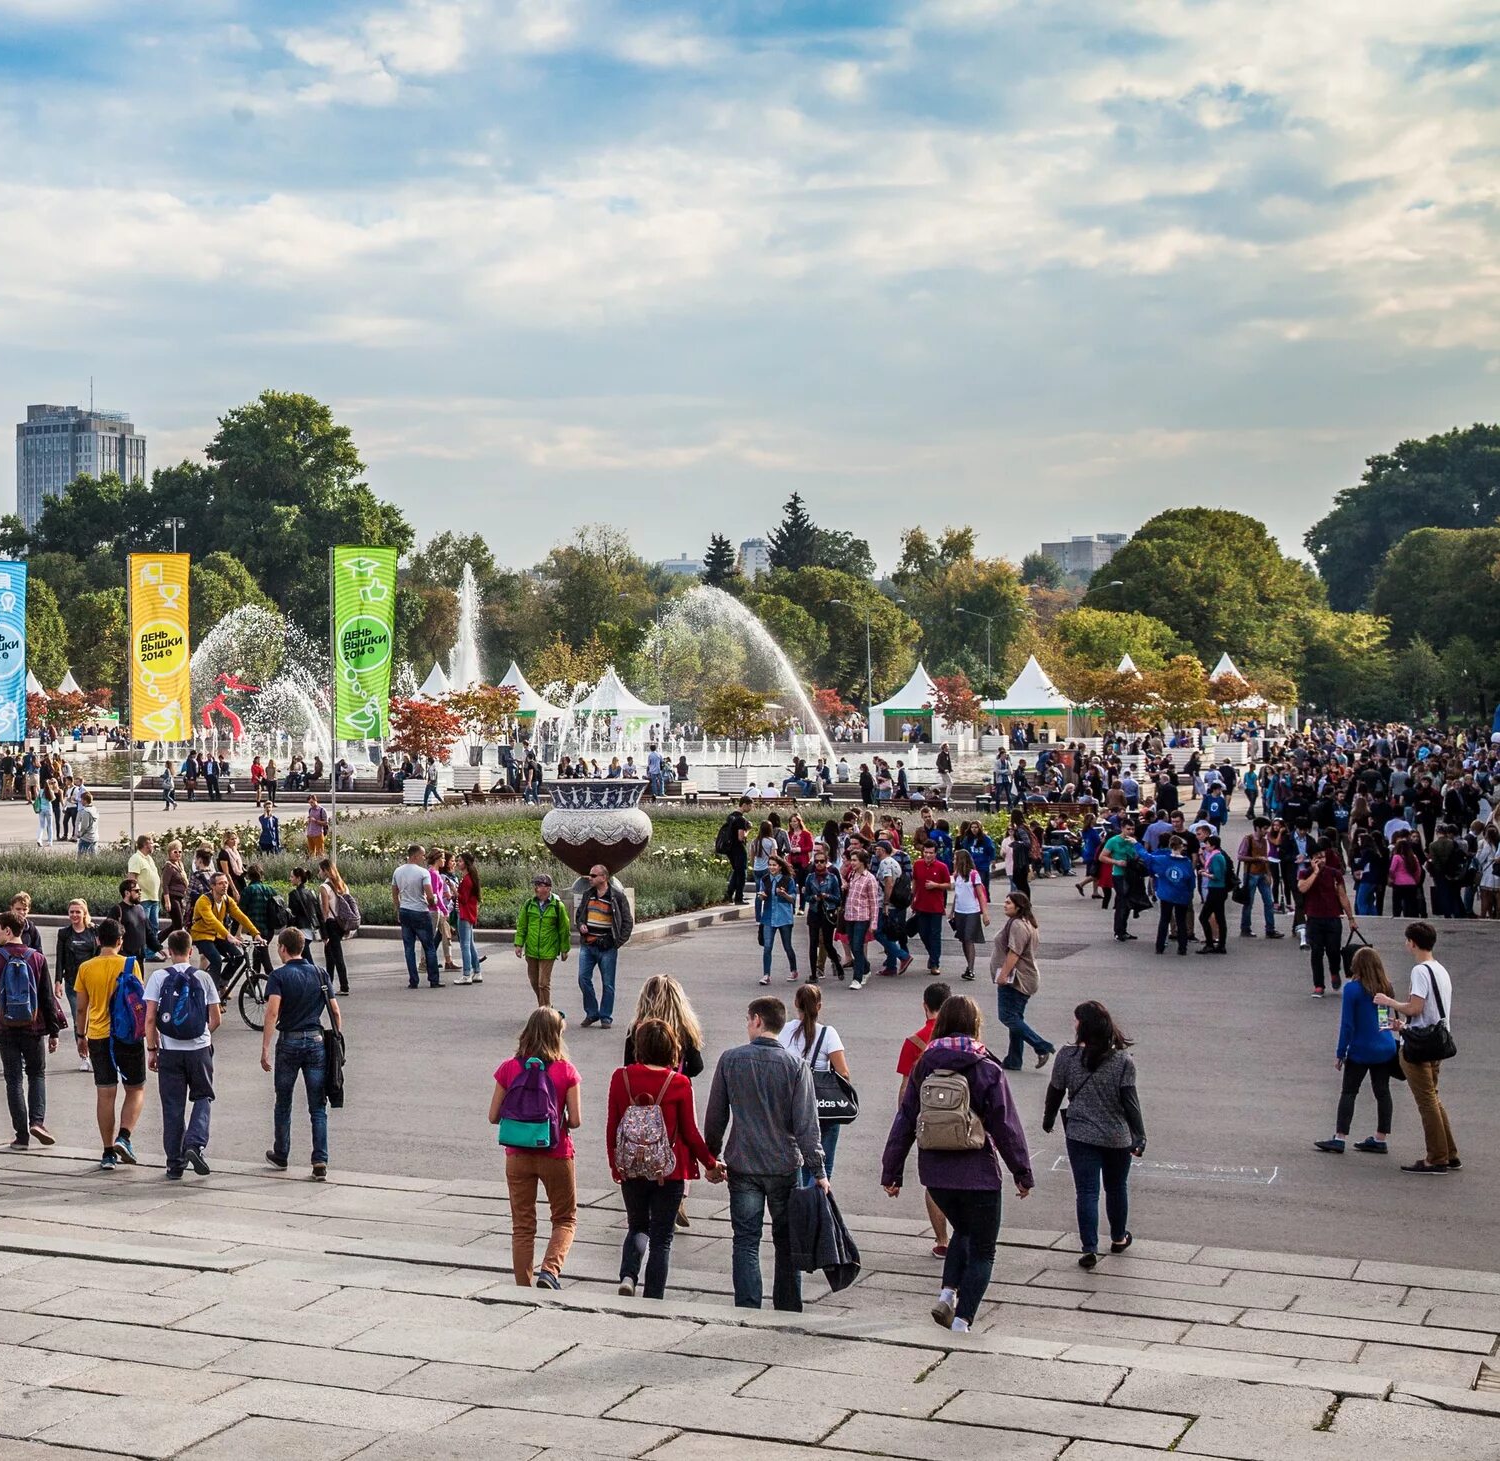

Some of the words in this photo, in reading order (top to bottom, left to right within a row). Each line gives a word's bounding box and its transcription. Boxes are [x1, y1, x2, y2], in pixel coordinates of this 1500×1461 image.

[141, 631, 168, 644] ДЕНЬ
[344, 628, 372, 641] ДЕНЬ
[141, 637, 183, 652] ВЫШКИ
[344, 635, 387, 650] ВЫШКИ
[141, 650, 164, 662] 2014
[344, 647, 366, 660] 2014
[816, 1099, 836, 1108] idas
